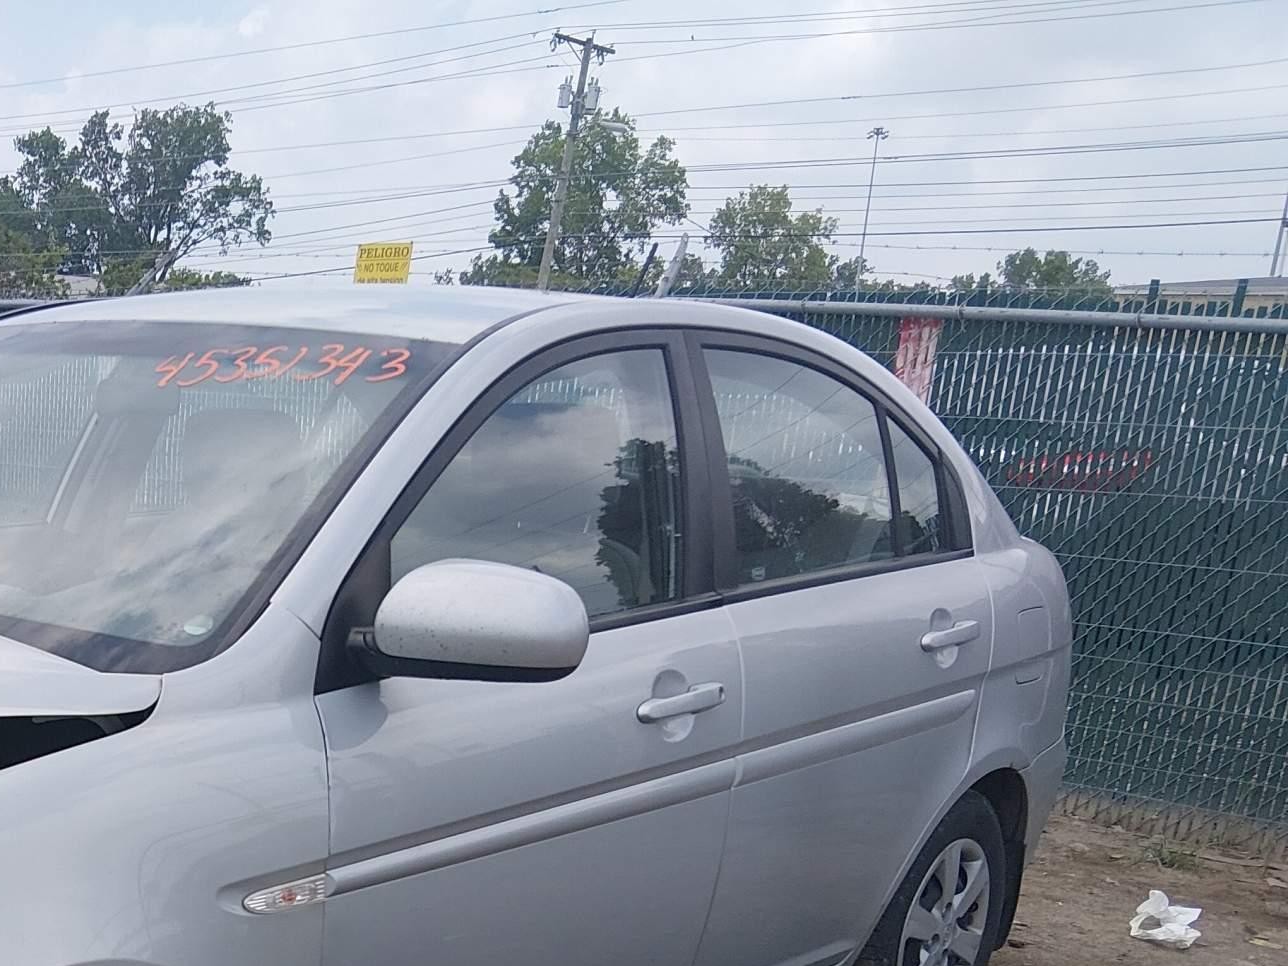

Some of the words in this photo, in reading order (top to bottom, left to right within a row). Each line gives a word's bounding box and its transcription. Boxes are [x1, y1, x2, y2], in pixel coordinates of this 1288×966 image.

[359, 247, 410, 258] PELIGRO
[364, 262, 374, 273] NO
[376, 262, 399, 273] TOQUE
[155, 343, 411, 388] 45351343
